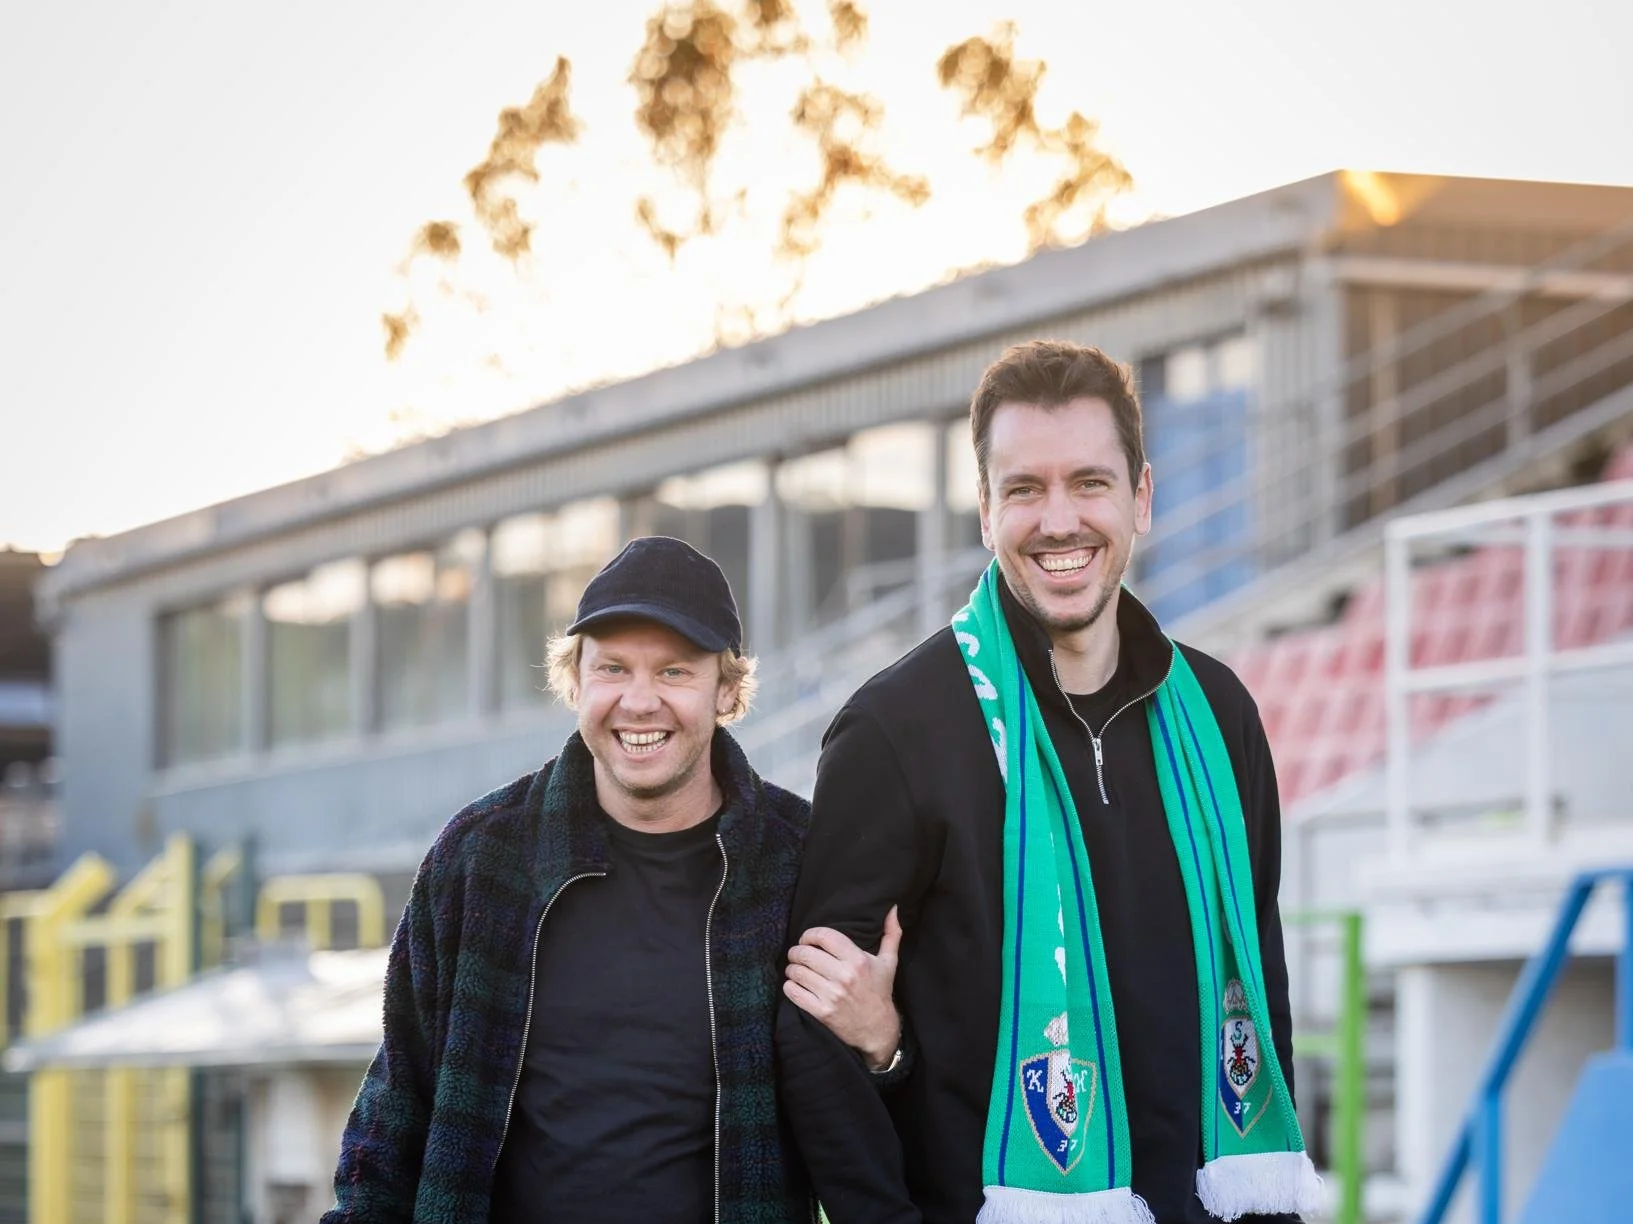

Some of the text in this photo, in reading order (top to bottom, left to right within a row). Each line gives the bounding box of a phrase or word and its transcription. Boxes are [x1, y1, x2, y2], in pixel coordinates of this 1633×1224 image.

[1026, 1069, 1044, 1093] K
[1232, 1101, 1251, 1114] 37
[1056, 1139, 1078, 1152] 37
